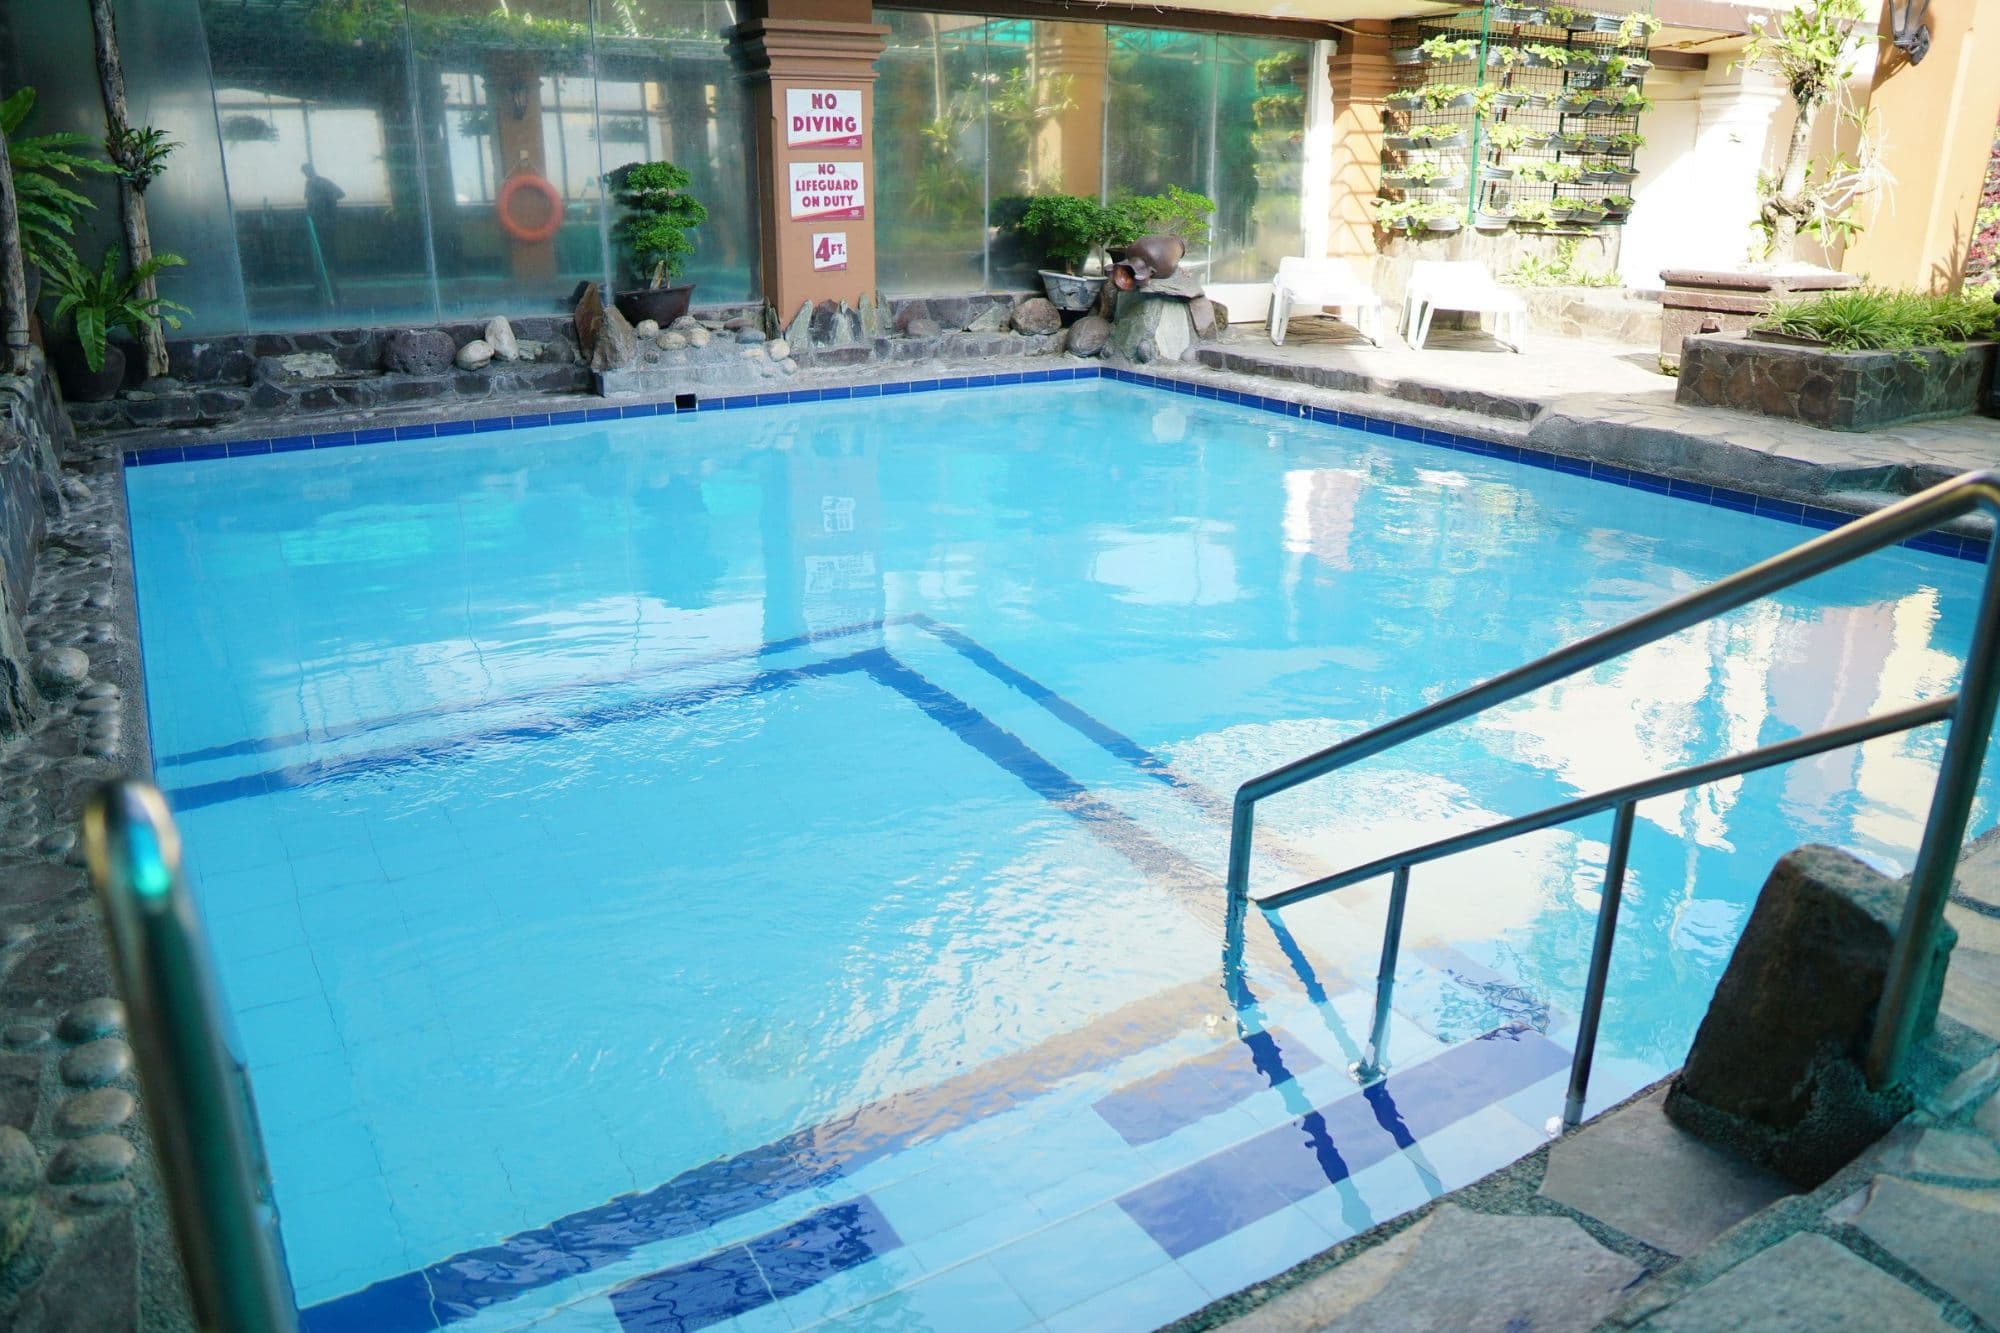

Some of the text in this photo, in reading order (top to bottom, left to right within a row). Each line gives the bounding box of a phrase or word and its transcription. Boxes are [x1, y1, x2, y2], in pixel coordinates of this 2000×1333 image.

[811, 93, 837, 110] NO
[793, 116, 857, 133] DIVING
[818, 163, 836, 175] NO
[795, 179, 859, 192] LIFEGUARD
[802, 195, 854, 208] ON DUTY
